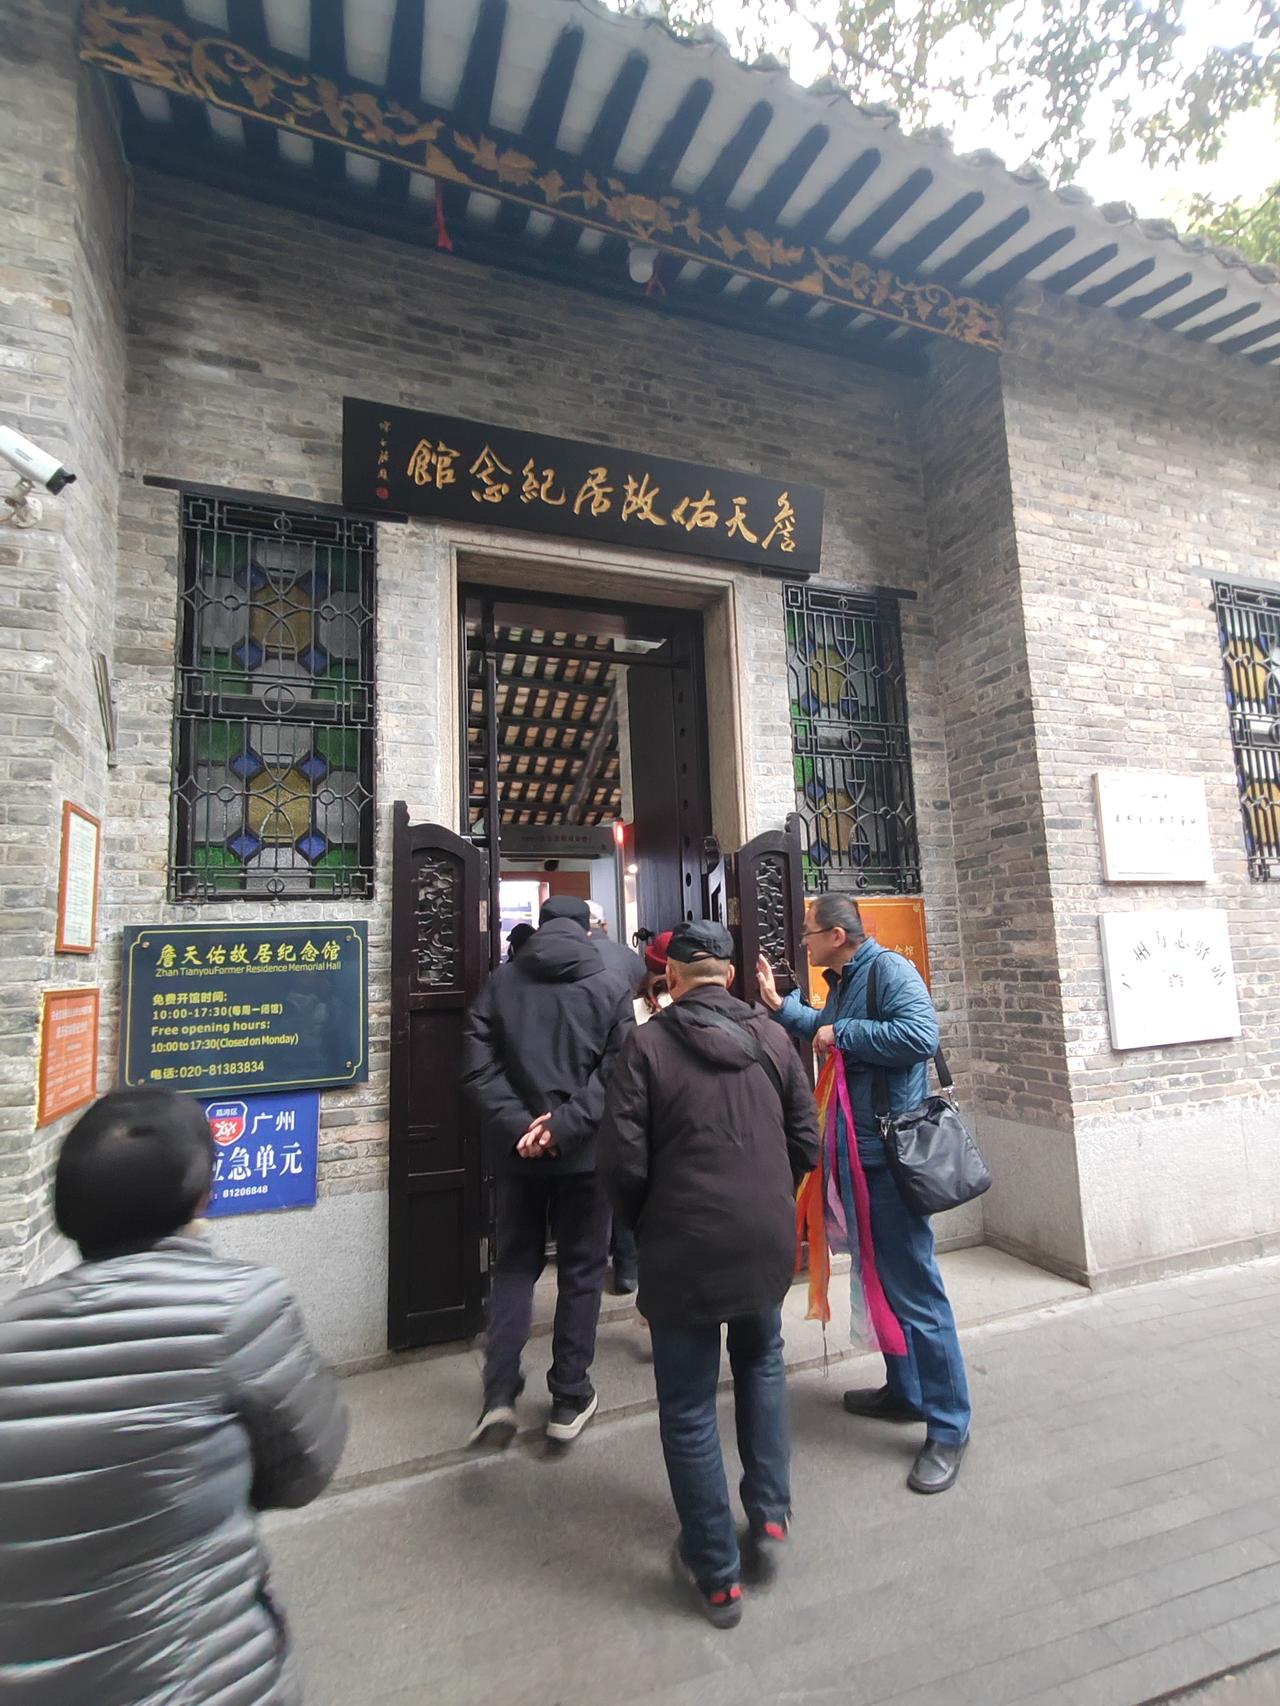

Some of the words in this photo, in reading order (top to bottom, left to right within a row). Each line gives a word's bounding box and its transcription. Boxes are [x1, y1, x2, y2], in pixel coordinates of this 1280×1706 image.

[156, 940, 341, 968] 詹天佑故居纪念馆
[155, 968, 179, 977] Zhan
[246, 963, 287, 974] Residence
[289, 961, 325, 972] Memorial
[326, 960, 342, 970] Hall
[151, 1026, 179, 1036] Free
[181, 1023, 230, 1036] opening
[233, 1020, 270, 1031] hours:
[151, 1042, 178, 1053] 10:00
[179, 1041, 189, 1051] to
[250, 1036, 261, 1046] on
[262, 1033, 299, 1046] Monday)
[251, 1110, 295, 1135] 广州
